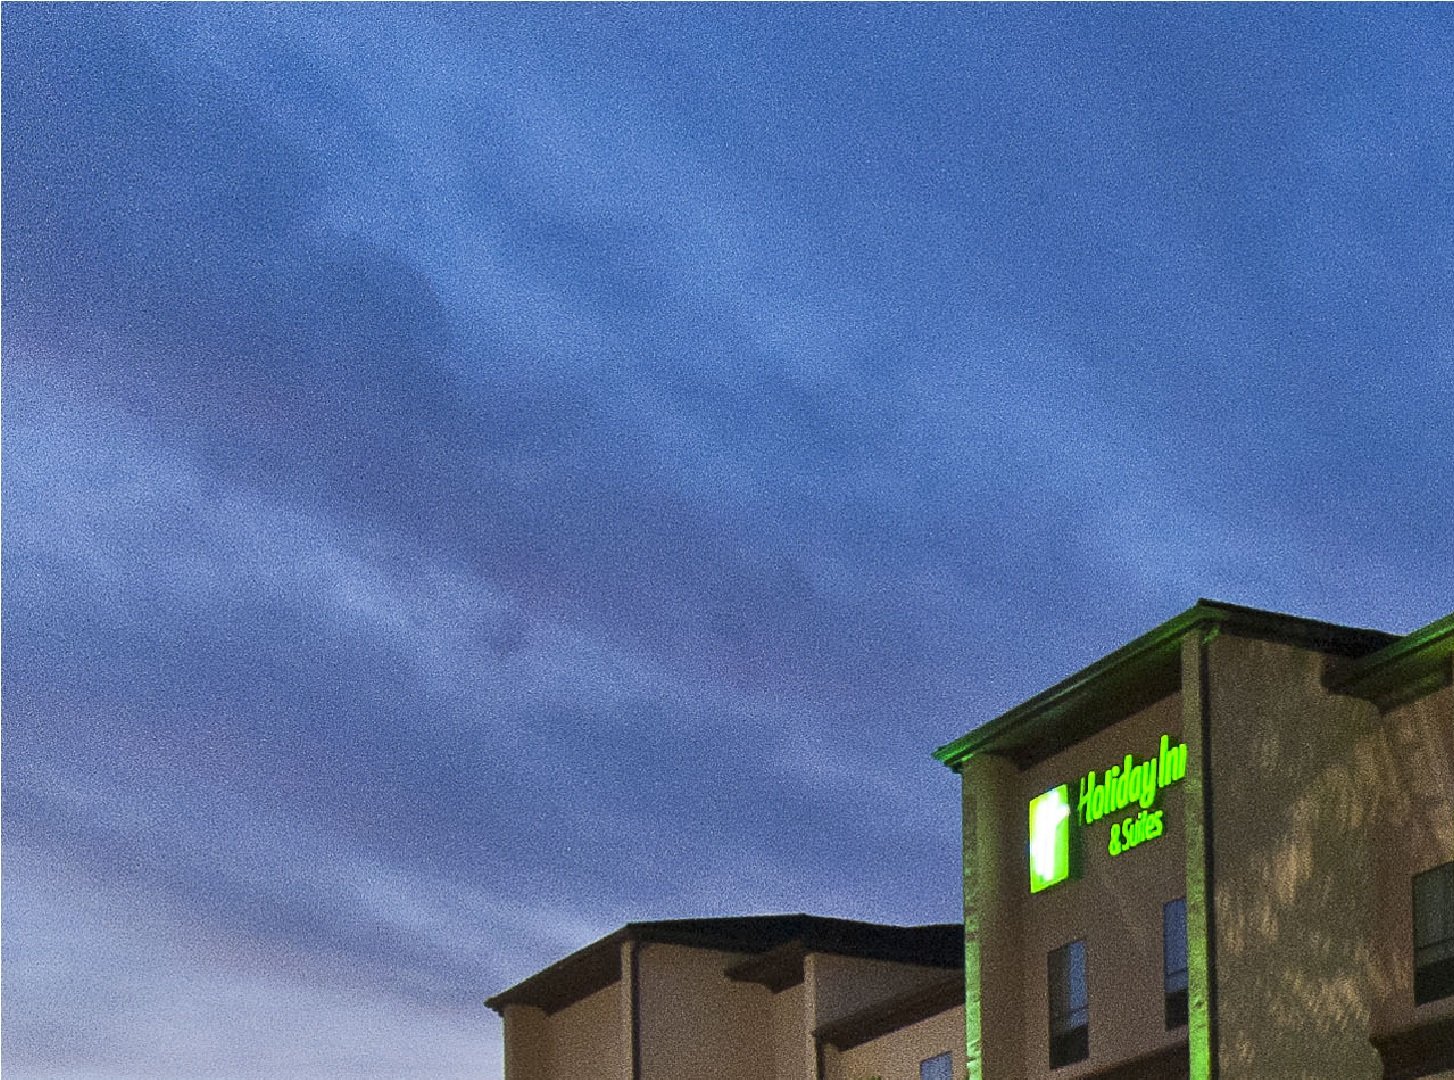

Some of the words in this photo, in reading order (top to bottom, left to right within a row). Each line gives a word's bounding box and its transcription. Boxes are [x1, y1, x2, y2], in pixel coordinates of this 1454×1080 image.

[1077, 754, 1158, 827] Holiday
[1157, 734, 1188, 788] Inn
[1107, 823, 1122, 856] &
[1121, 809, 1164, 852] Suites
